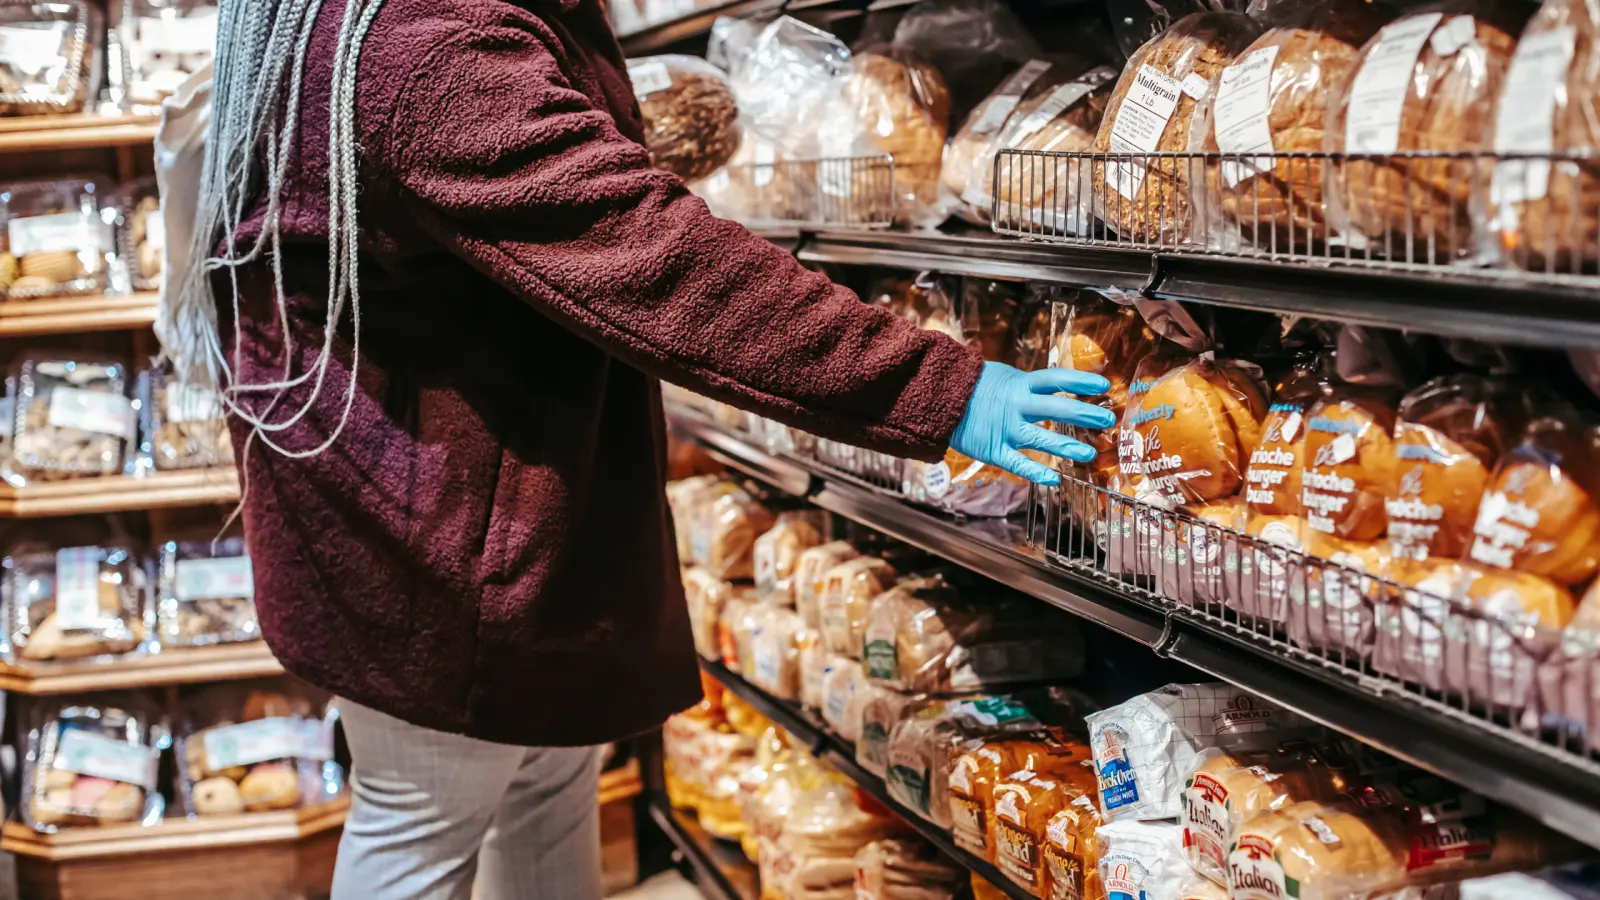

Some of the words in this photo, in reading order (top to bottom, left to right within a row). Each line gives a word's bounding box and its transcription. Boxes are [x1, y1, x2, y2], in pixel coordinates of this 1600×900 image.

[1144, 66, 1155, 74] ALL
[1155, 70, 1176, 87] NATURAL
[1137, 73, 1176, 102] Multigrain
[1145, 425, 1161, 454] the
[1246, 484, 1275, 505] buns
[1225, 711, 1271, 721] ARNOLD
[1116, 767, 1137, 786] Oven
[1108, 880, 1133, 890] ARNOLD
